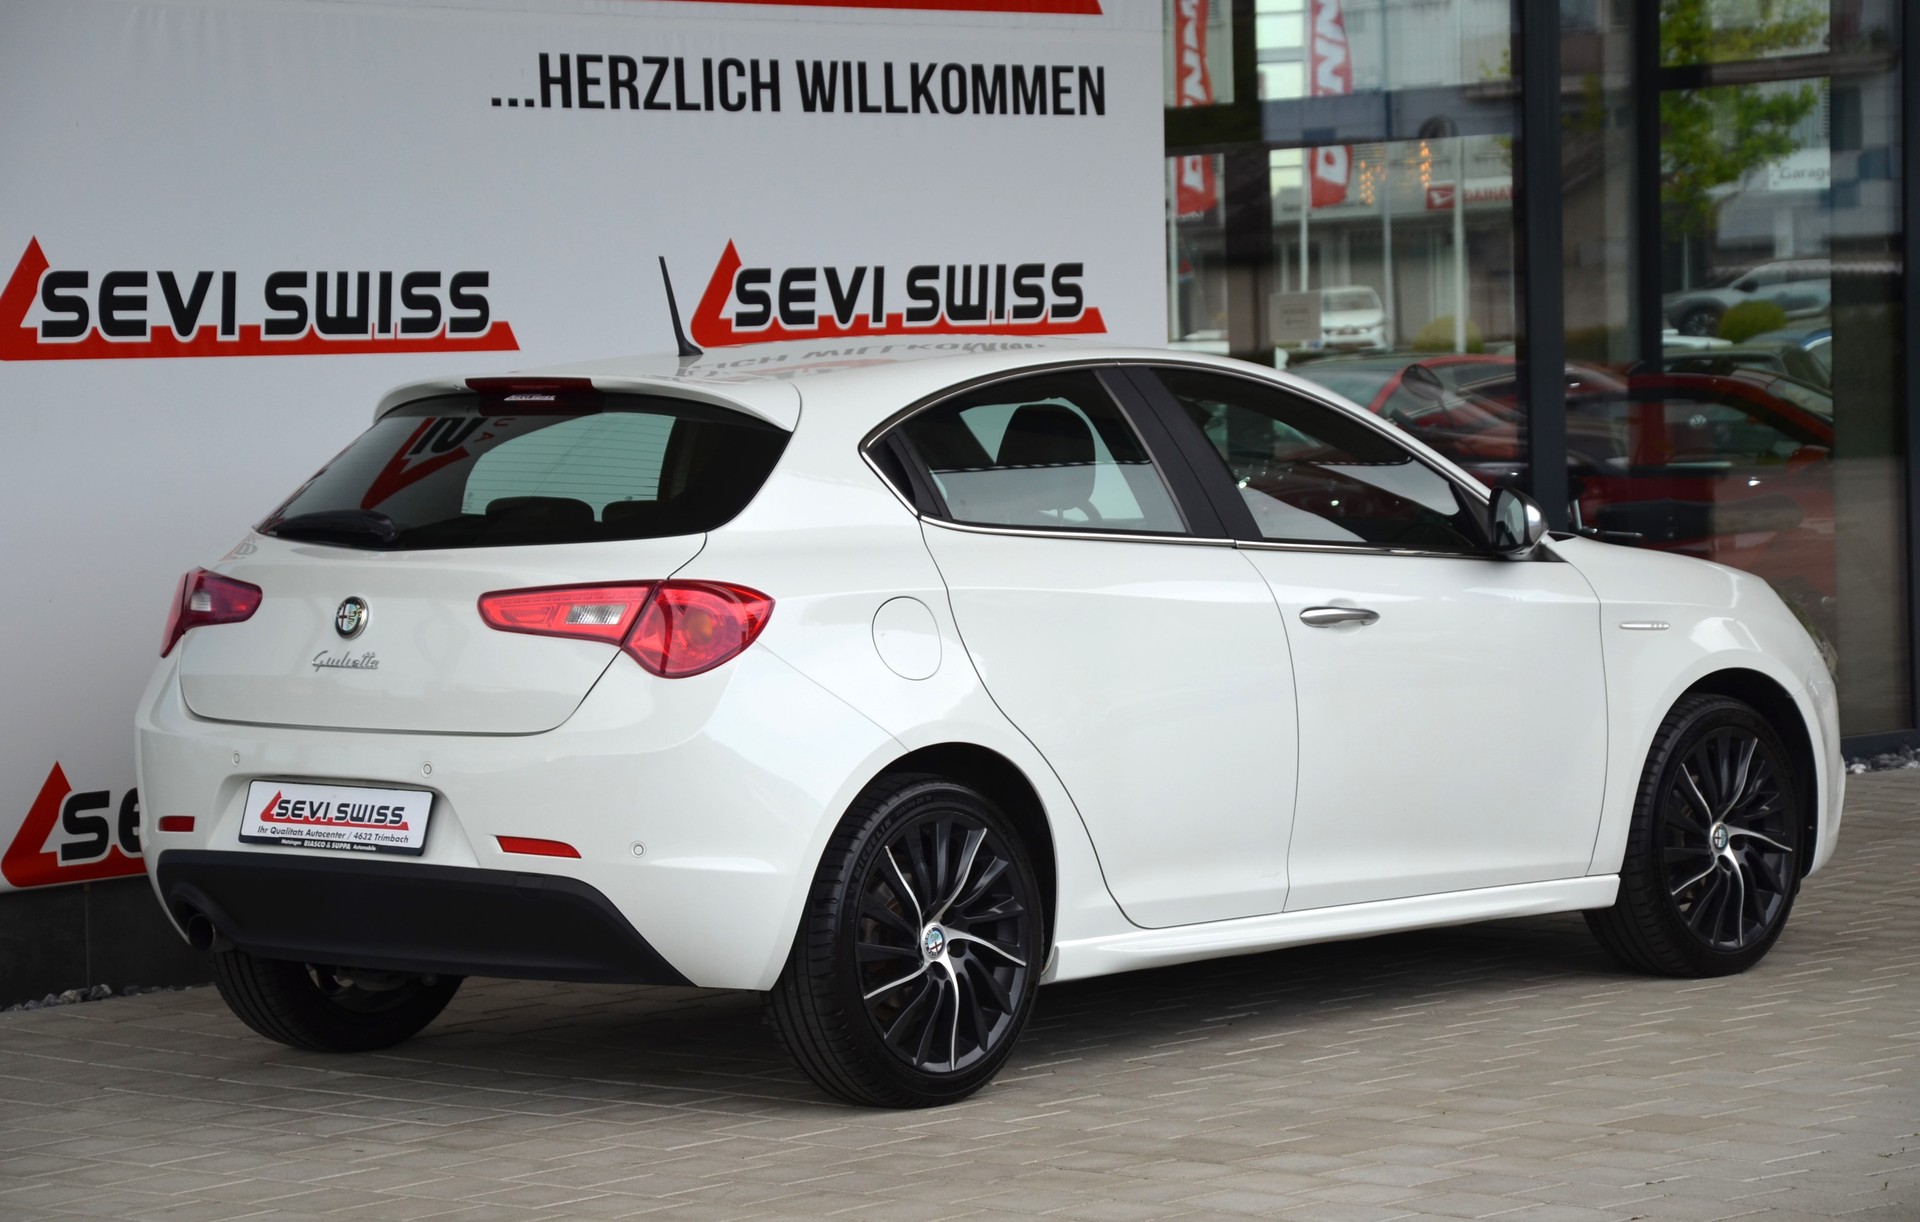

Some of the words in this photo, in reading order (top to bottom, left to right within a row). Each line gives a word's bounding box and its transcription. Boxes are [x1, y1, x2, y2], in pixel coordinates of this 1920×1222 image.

[796, 59, 1106, 116] WILLKOMMEN
[41, 270, 237, 338] SEVI
[264, 270, 490, 336] SWISS
[734, 265, 886, 328] SEVI
[905, 262, 1084, 322] SWISS
[312, 650, 379, 672] Giulietta
[61, 787, 142, 861] SE
[275, 799, 330, 820] SEVI
[335, 803, 405, 825] SWISS
[257, 826, 268, 834] Ihr
[305, 829, 346, 839] Autocenter
[354, 832, 373, 841] 4632
[374, 834, 409, 843] Trimbach
[303, 840, 326, 848] BIASCO
[331, 842, 351, 850] SUPPA
